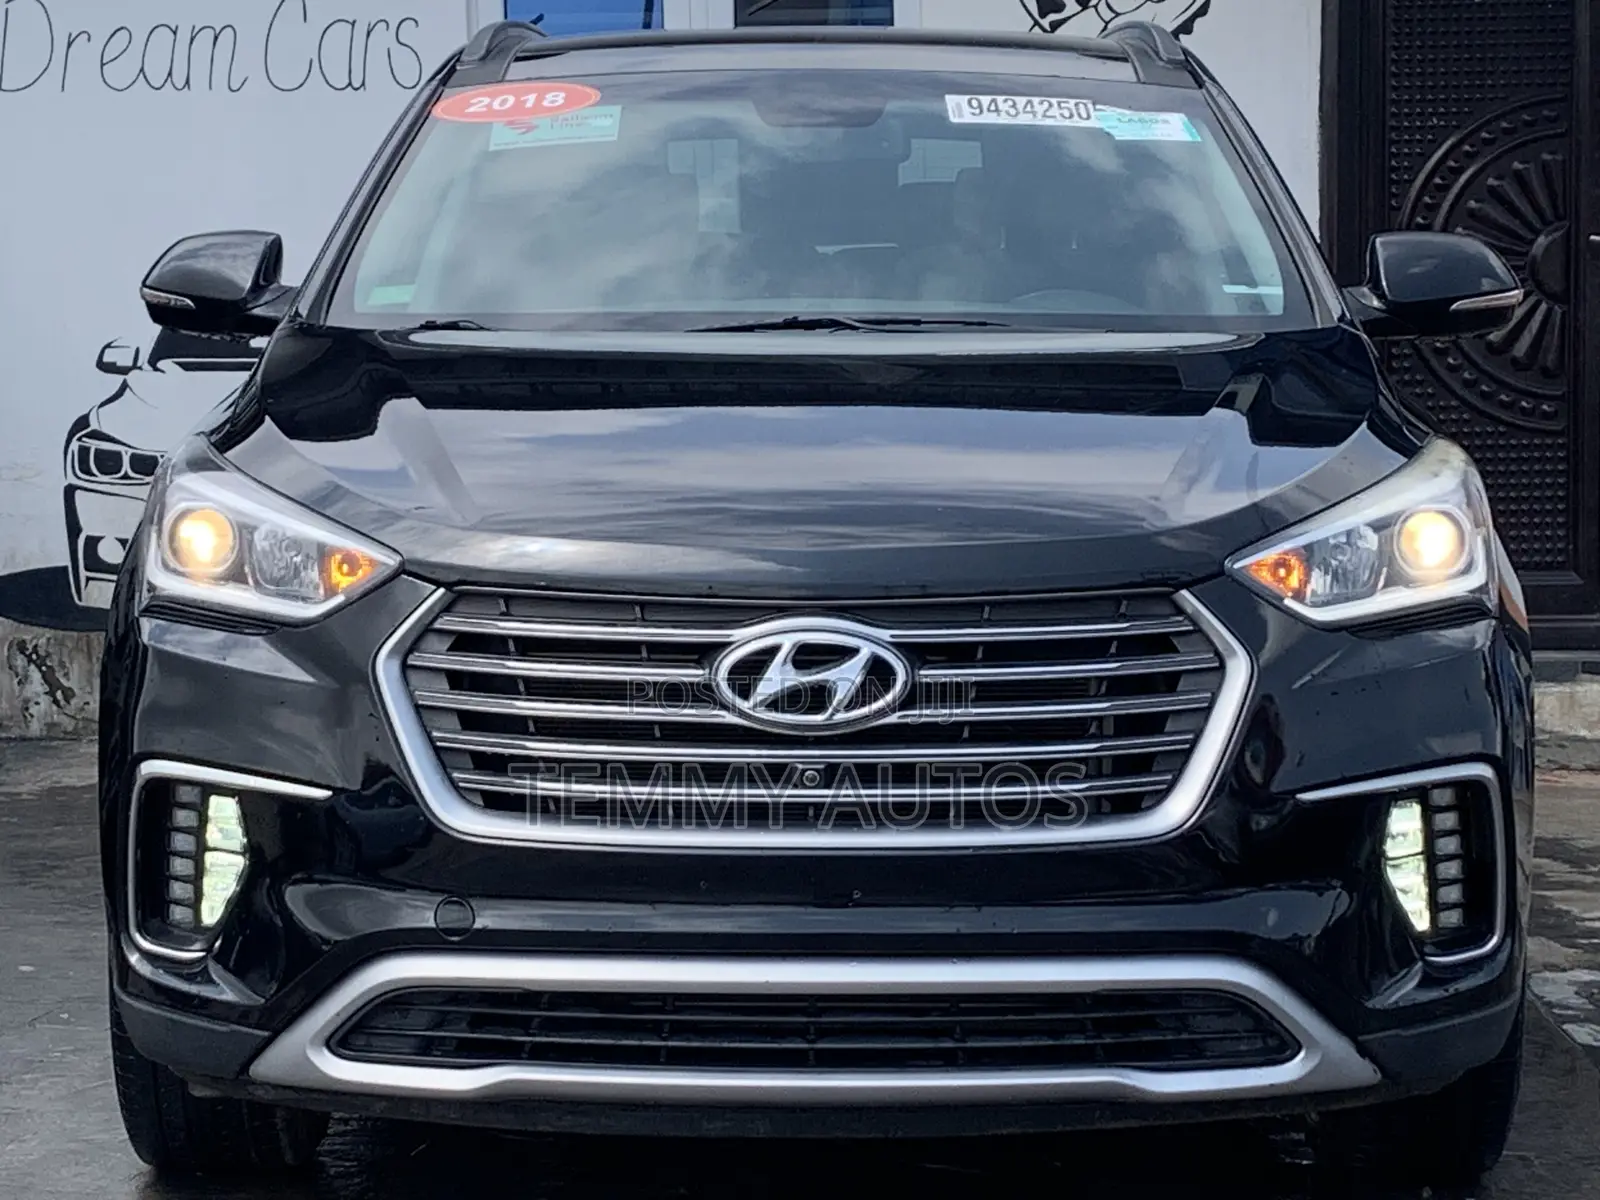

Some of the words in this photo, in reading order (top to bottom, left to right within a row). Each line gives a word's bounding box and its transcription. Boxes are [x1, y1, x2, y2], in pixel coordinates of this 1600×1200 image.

[0, 0, 248, 92] Dream
[264, 0, 422, 91] Cars
[464, 91, 567, 113] 2018
